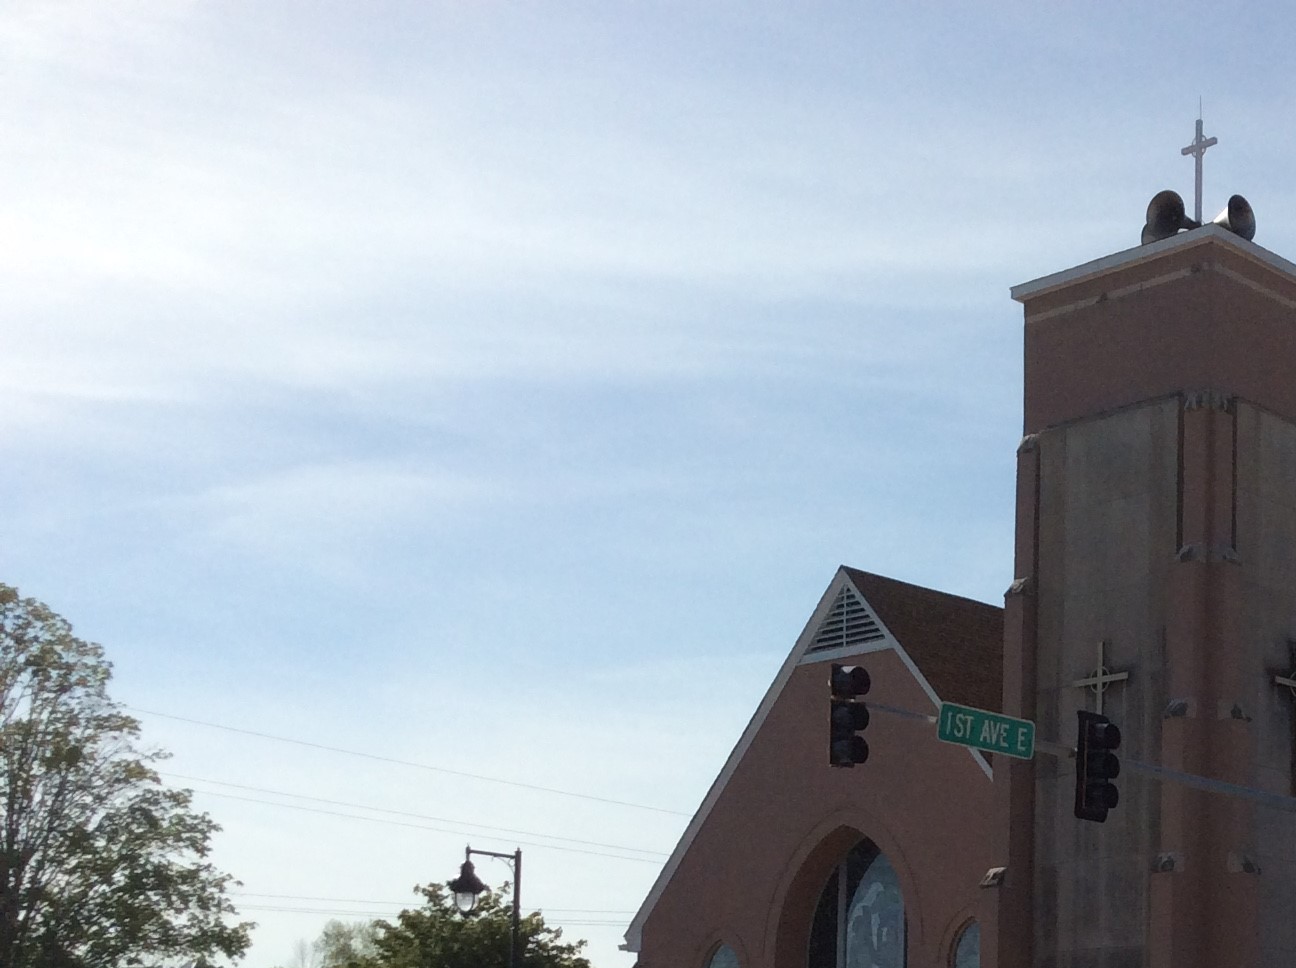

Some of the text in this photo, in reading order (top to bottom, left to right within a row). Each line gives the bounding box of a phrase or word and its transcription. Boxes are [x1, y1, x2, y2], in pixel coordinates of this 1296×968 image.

[946, 711, 1028, 751] 1ST AVE E
